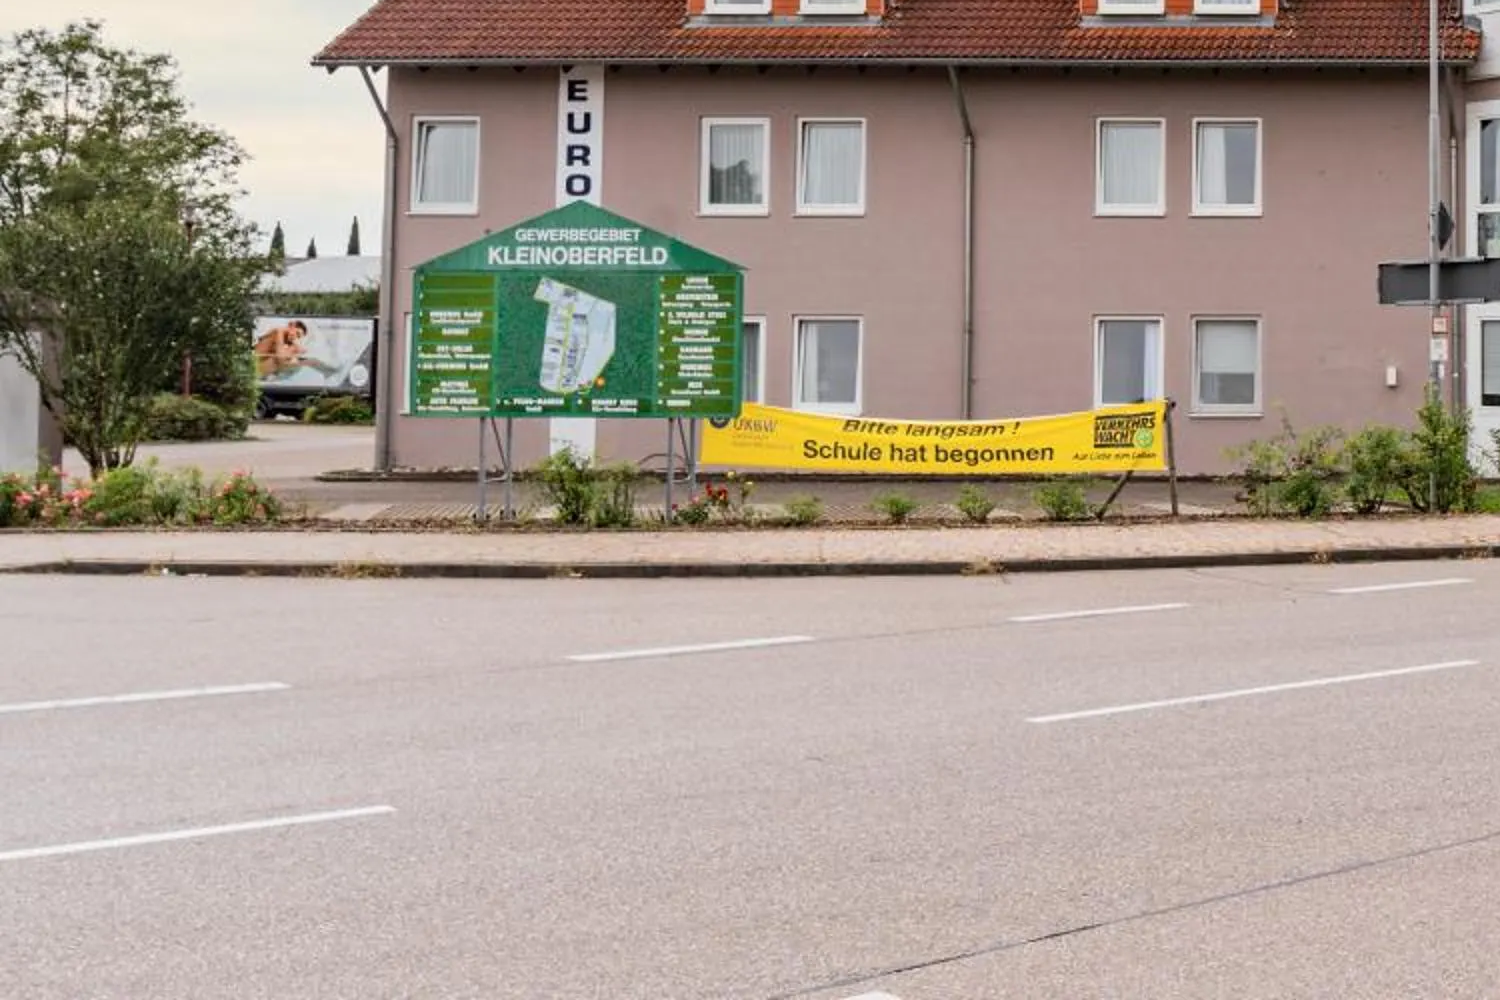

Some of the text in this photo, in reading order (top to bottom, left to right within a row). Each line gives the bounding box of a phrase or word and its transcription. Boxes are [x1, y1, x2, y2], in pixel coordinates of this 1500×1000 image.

[566, 79, 591, 196] EURO
[515, 228, 642, 242] GEWERBEGEBIET
[488, 246, 668, 265] KLEINOBERFELD
[842, 419, 899, 435] Bitte
[905, 423, 1005, 440] langsam
[803, 440, 882, 461] Schule
[890, 443, 928, 462] hat
[935, 443, 1055, 467] begonnen
